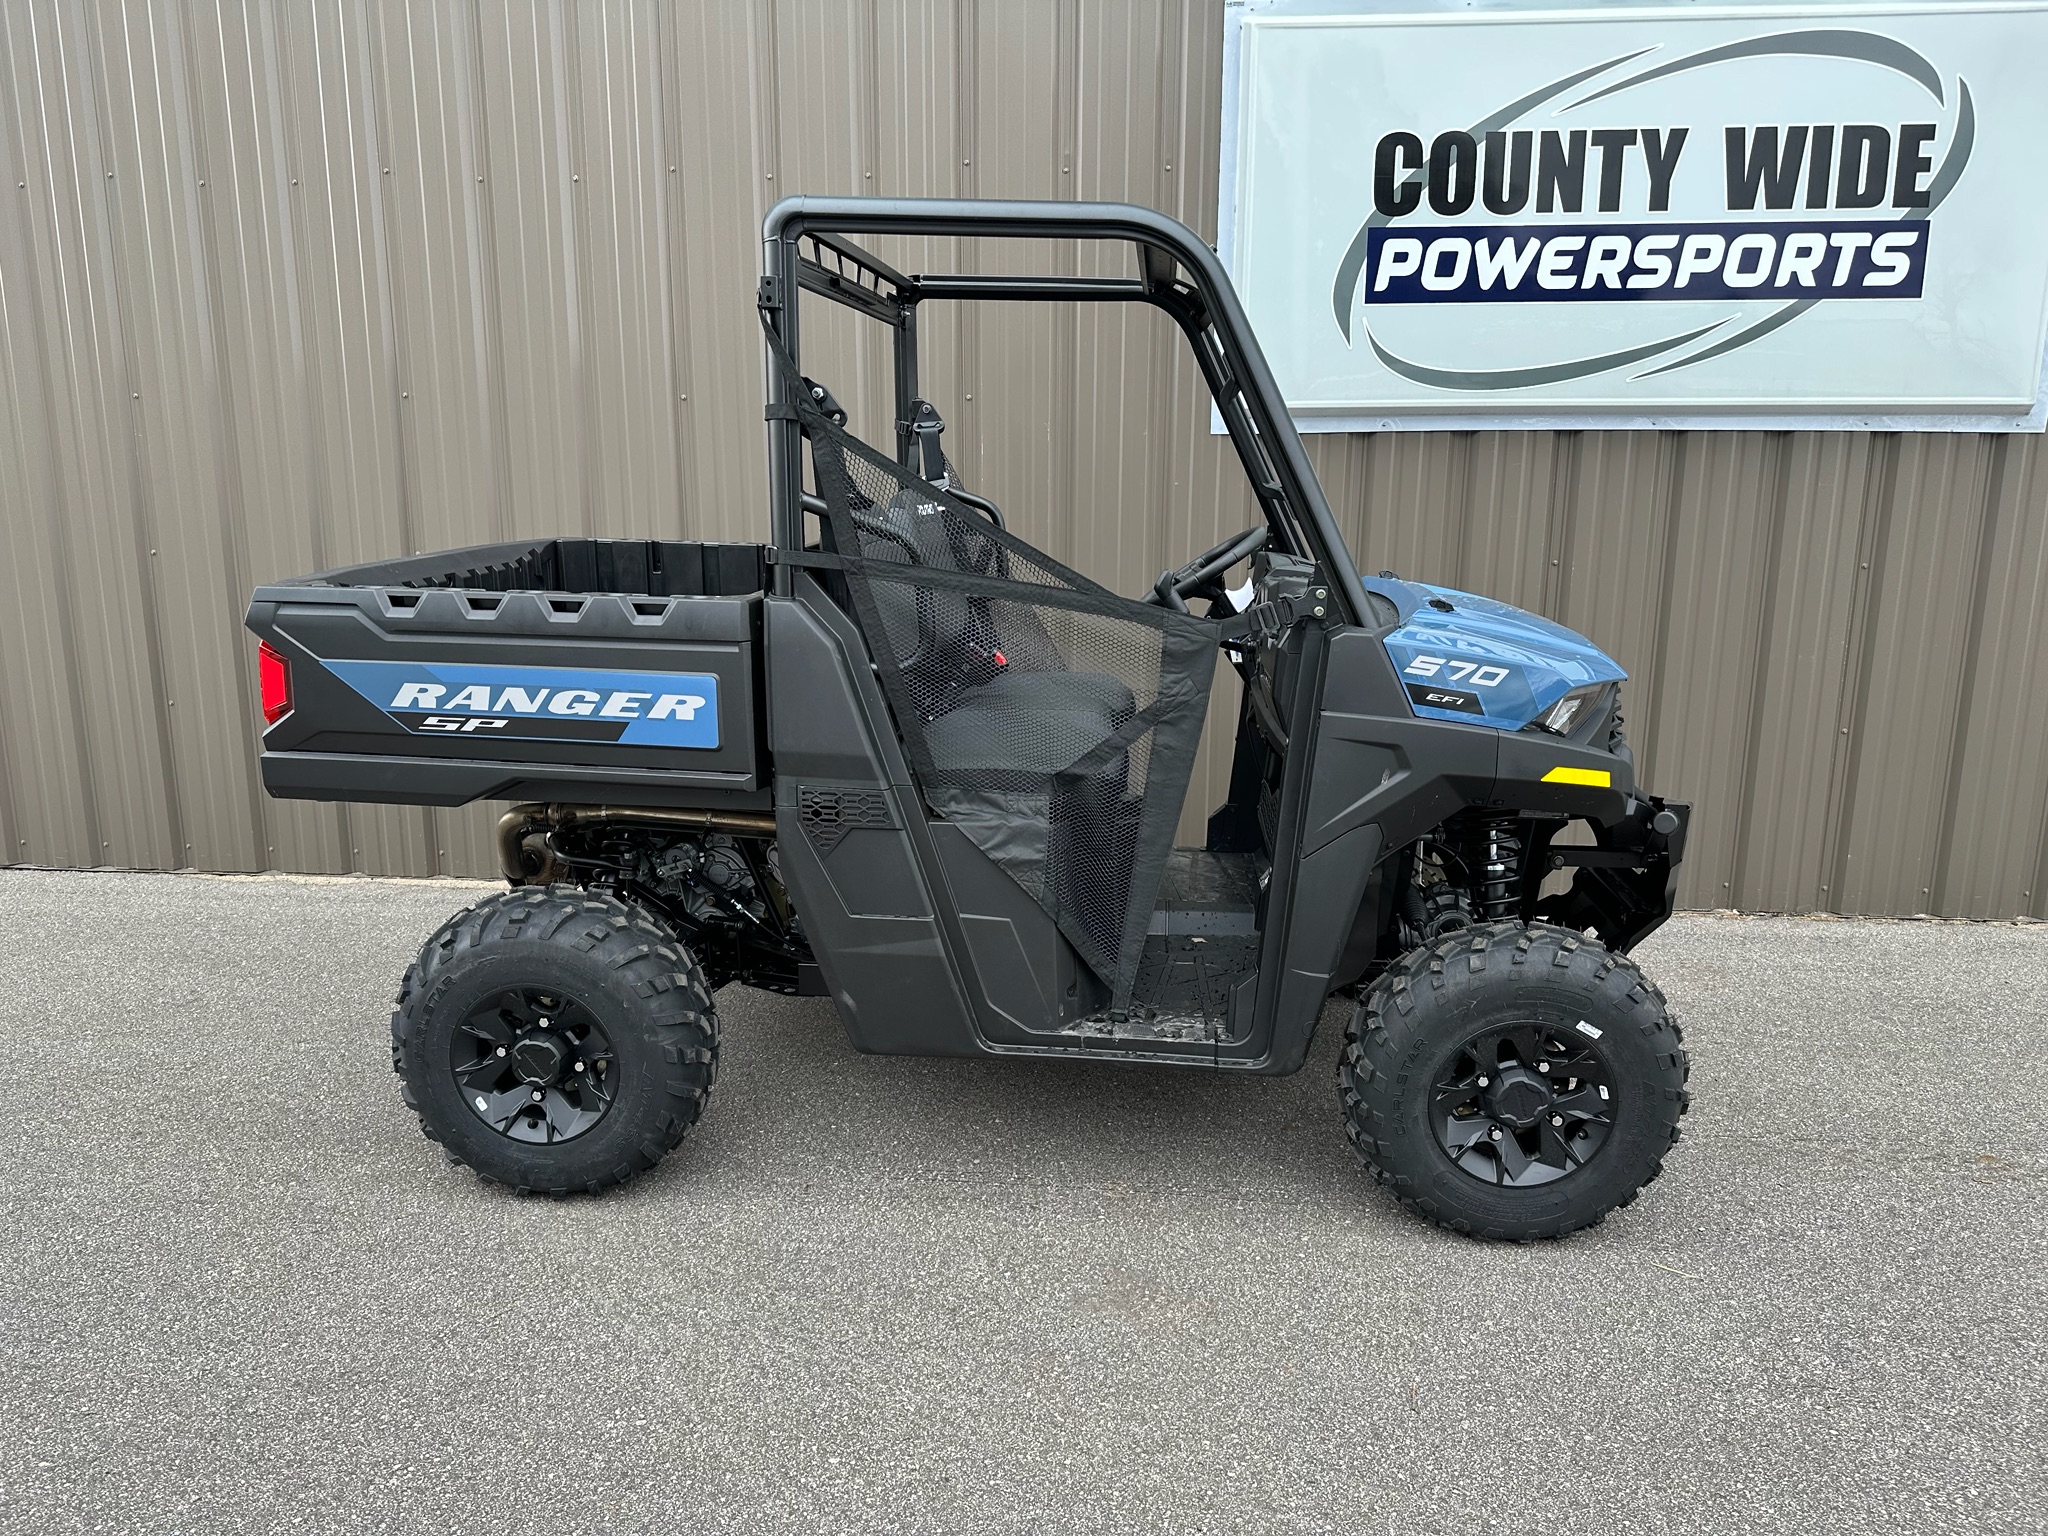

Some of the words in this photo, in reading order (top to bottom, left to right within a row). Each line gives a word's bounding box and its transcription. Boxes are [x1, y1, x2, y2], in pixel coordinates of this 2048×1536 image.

[1374, 128, 1689, 217] COUNTY
[1725, 124, 1937, 210] WIDE
[1374, 231, 1920, 292] POWERSPORTS
[1403, 655, 1510, 687] 570
[390, 682, 706, 721] RANGER
[418, 716, 510, 732] SP
[1425, 693, 1465, 705] EFI
[414, 975, 457, 1063] CARLSTAR
[1392, 1038, 1429, 1136] CARLSTAR
